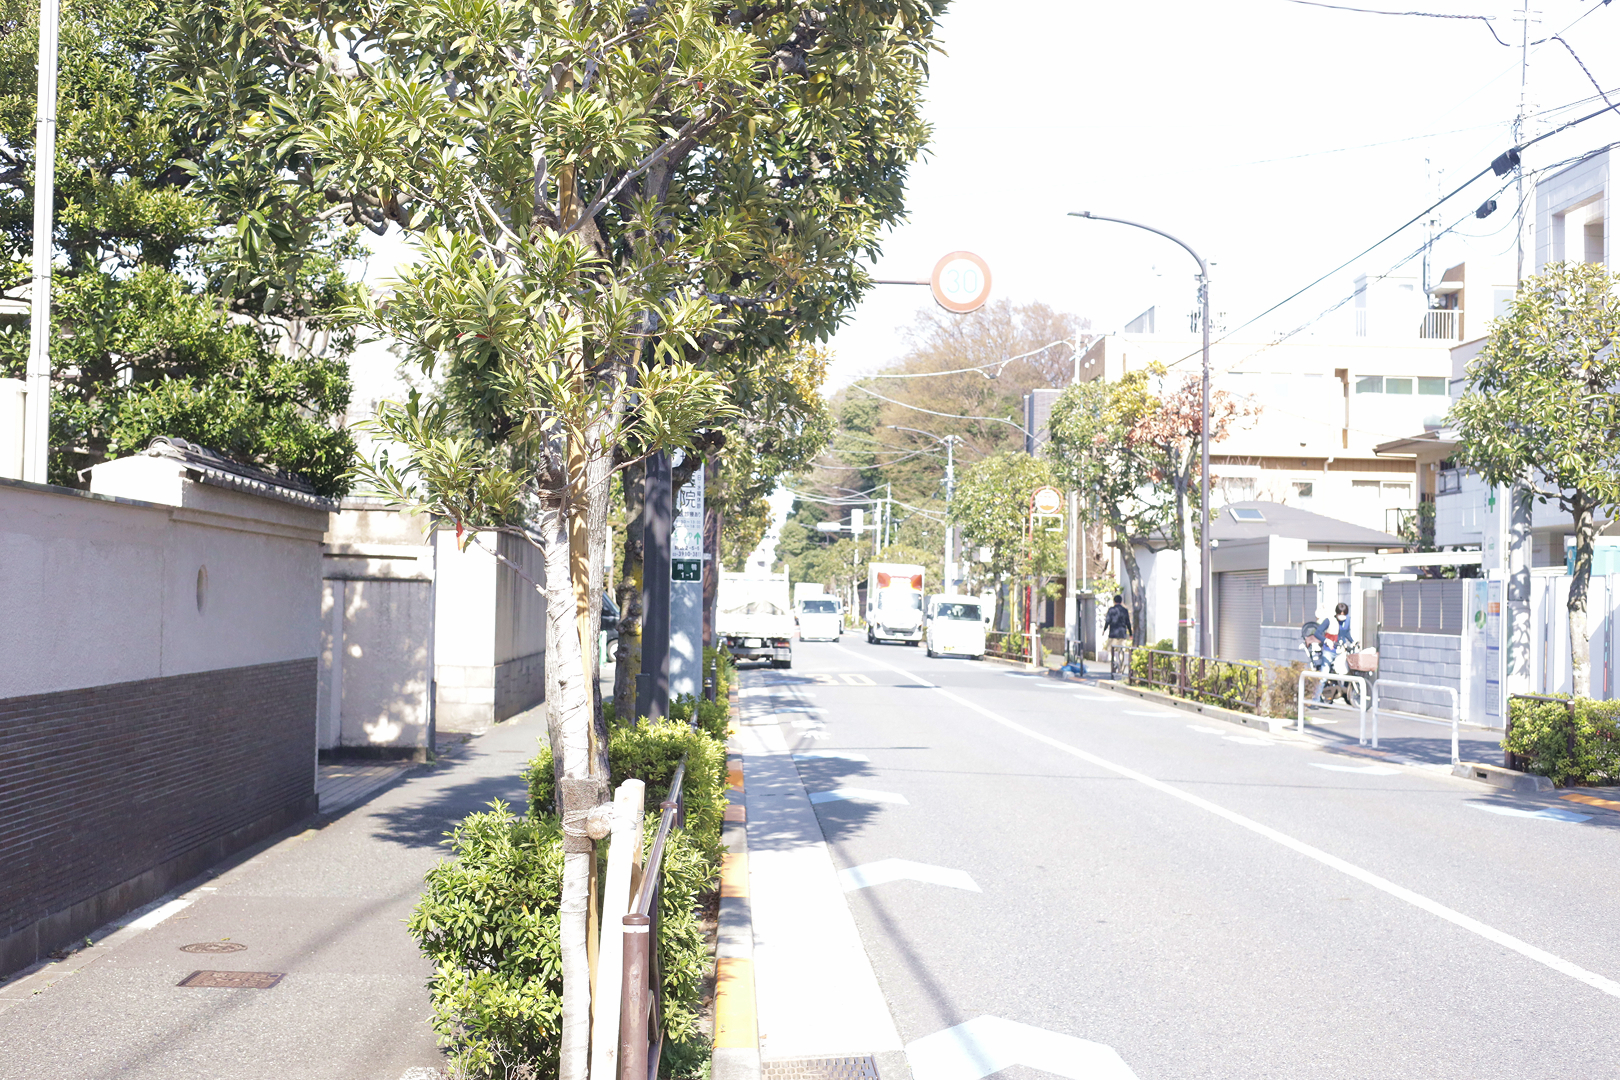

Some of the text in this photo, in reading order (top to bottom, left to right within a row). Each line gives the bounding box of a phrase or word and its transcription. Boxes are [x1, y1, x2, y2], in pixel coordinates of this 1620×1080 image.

[946, 269, 978, 293] 30
[680, 571, 694, 579] 1-1
[804, 673, 878, 686] 30
